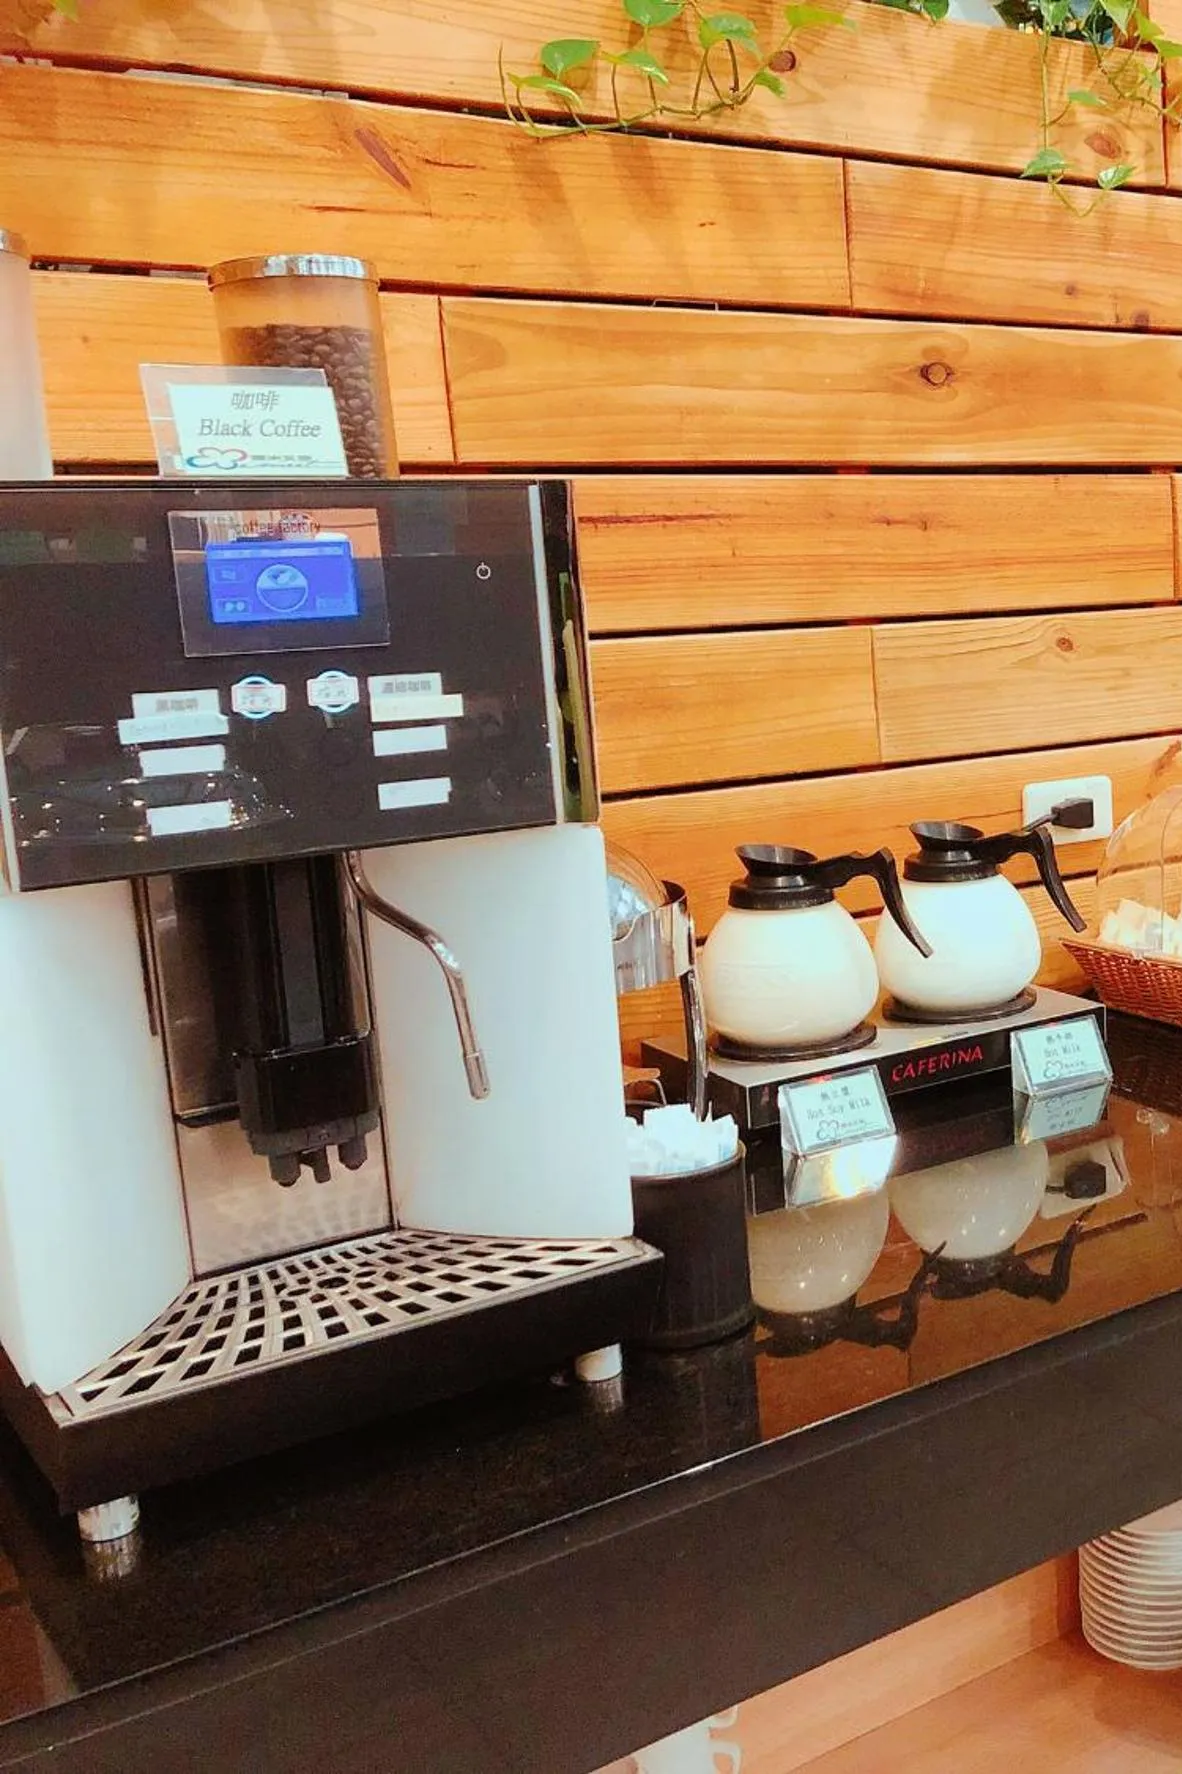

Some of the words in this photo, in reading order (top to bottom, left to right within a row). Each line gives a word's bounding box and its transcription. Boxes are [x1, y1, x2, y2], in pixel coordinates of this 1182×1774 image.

[199, 419, 252, 437] Black
[259, 419, 321, 438] Coffee
[891, 1045, 984, 1082] CAFERINA
